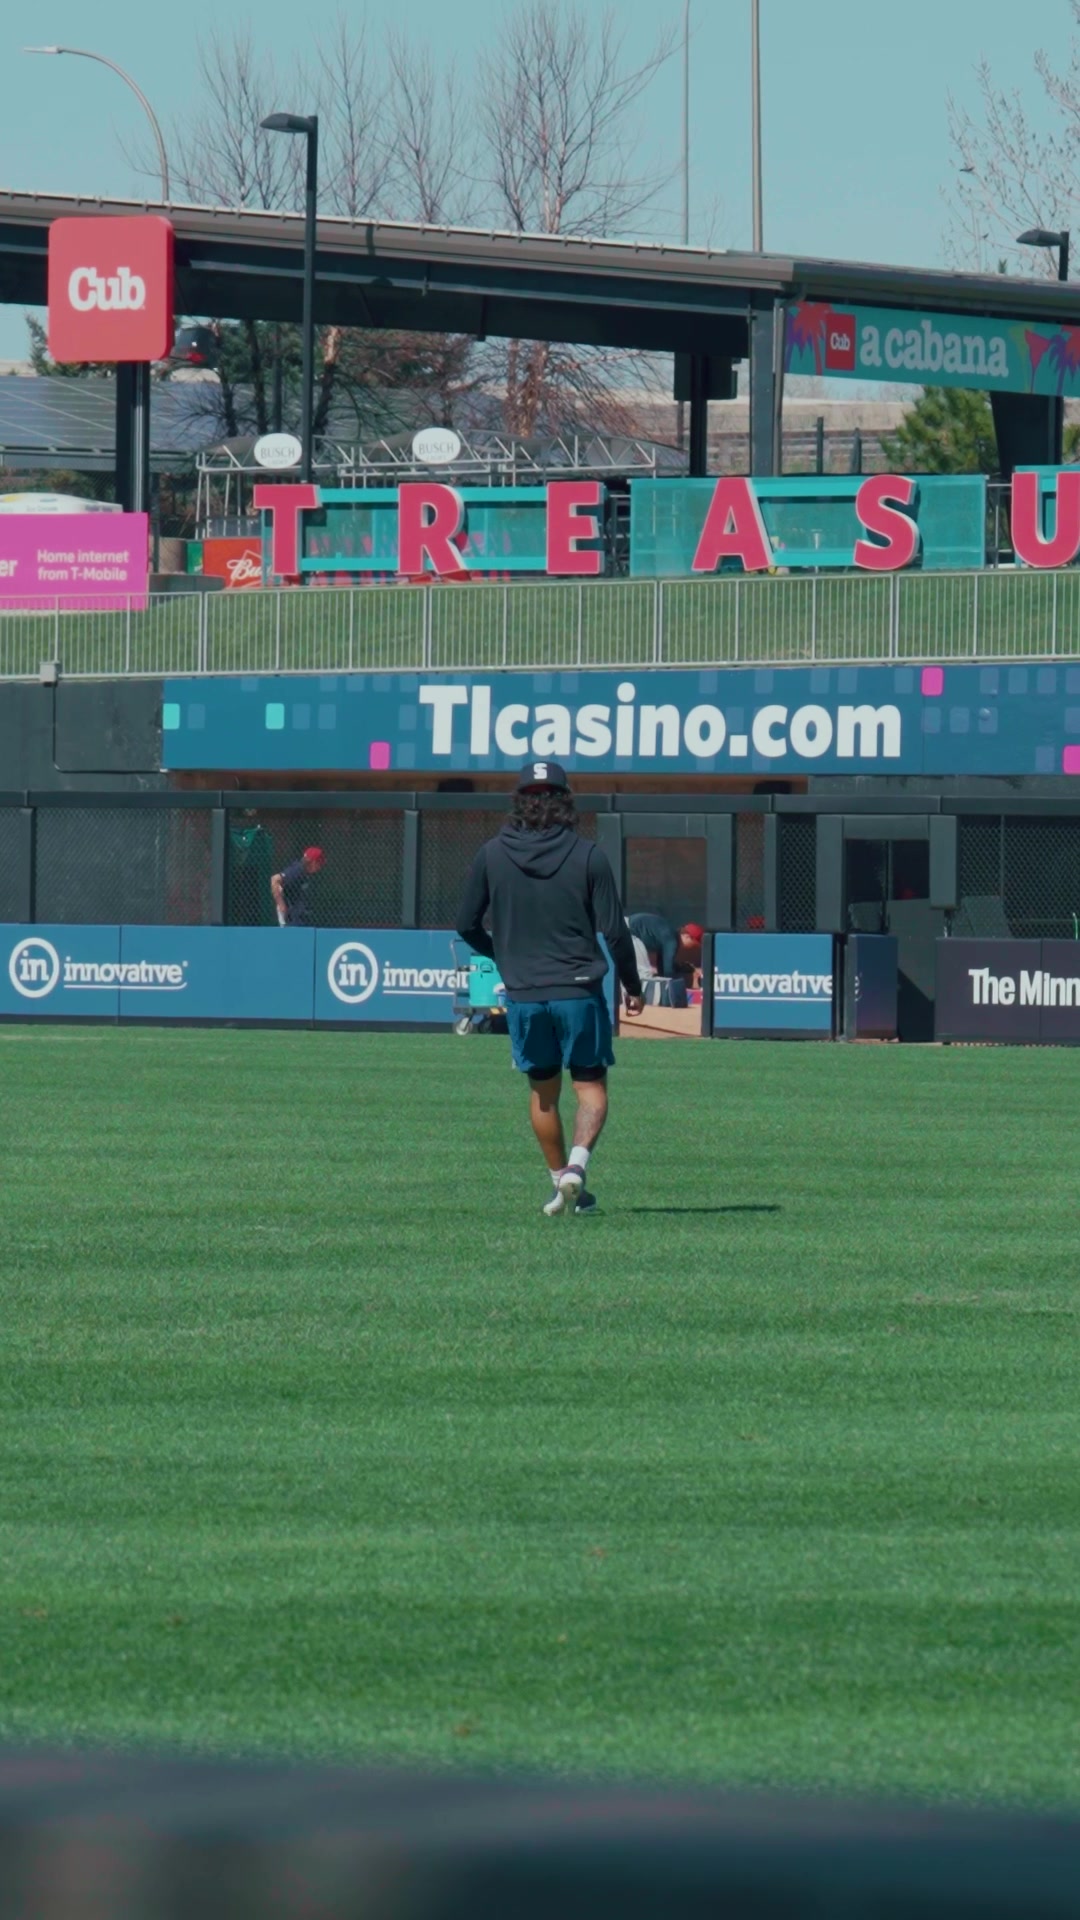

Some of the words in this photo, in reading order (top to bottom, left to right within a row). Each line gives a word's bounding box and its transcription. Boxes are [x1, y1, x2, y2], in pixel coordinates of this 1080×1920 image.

[68, 266, 146, 312] Cub
[830, 332, 851, 351] Cub
[260, 447, 295, 459] BUSCH
[418, 442, 454, 455] BUSCH
[37, 549, 74, 563] Home
[77, 549, 129, 563] internet
[38, 567, 68, 581] from
[70, 566, 128, 581] T-Mobile
[533, 762, 548, 780] S
[19, 949, 50, 982] in
[63, 956, 184, 984] innovative
[338, 954, 369, 987] in
[968, 967, 1016, 1005] The
[1020, 970, 1080, 1007] Minn
